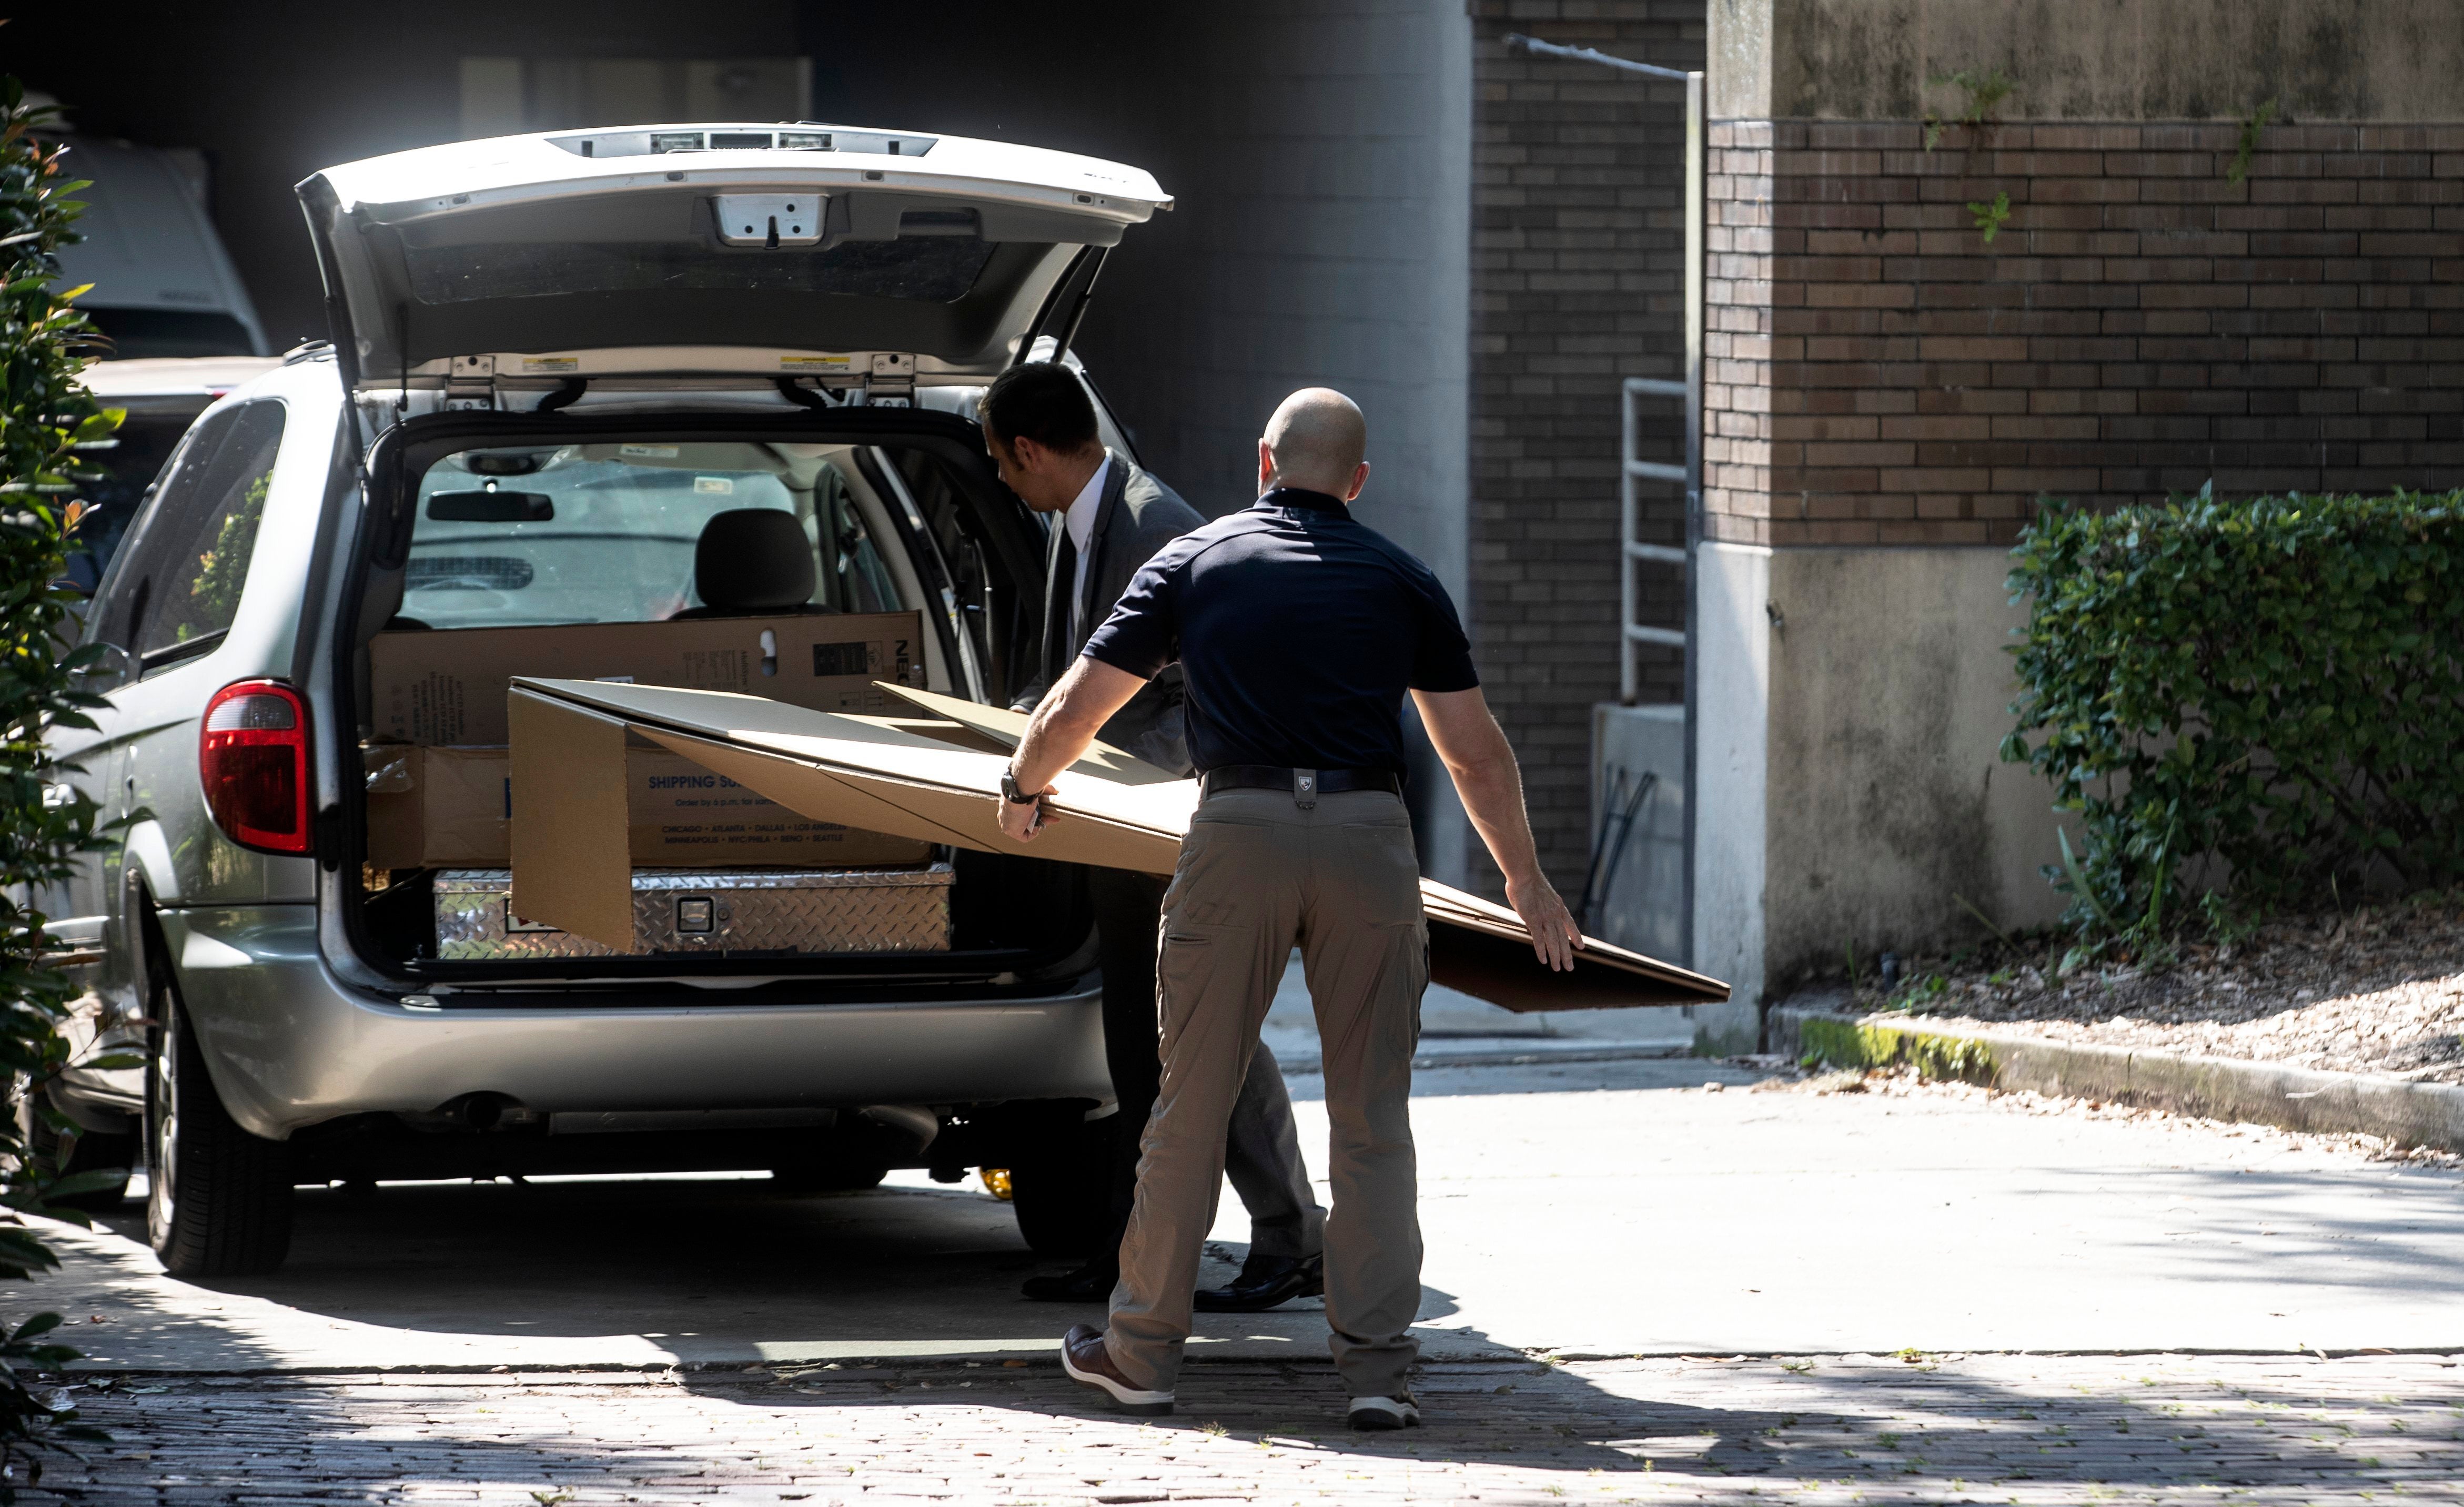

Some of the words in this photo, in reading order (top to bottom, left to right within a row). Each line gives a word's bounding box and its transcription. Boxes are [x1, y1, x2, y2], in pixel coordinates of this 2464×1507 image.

[895, 640, 909, 686] NEC
[649, 776, 715, 788] SHIPPING
[719, 775, 741, 787] SU
[700, 798, 710, 807] by
